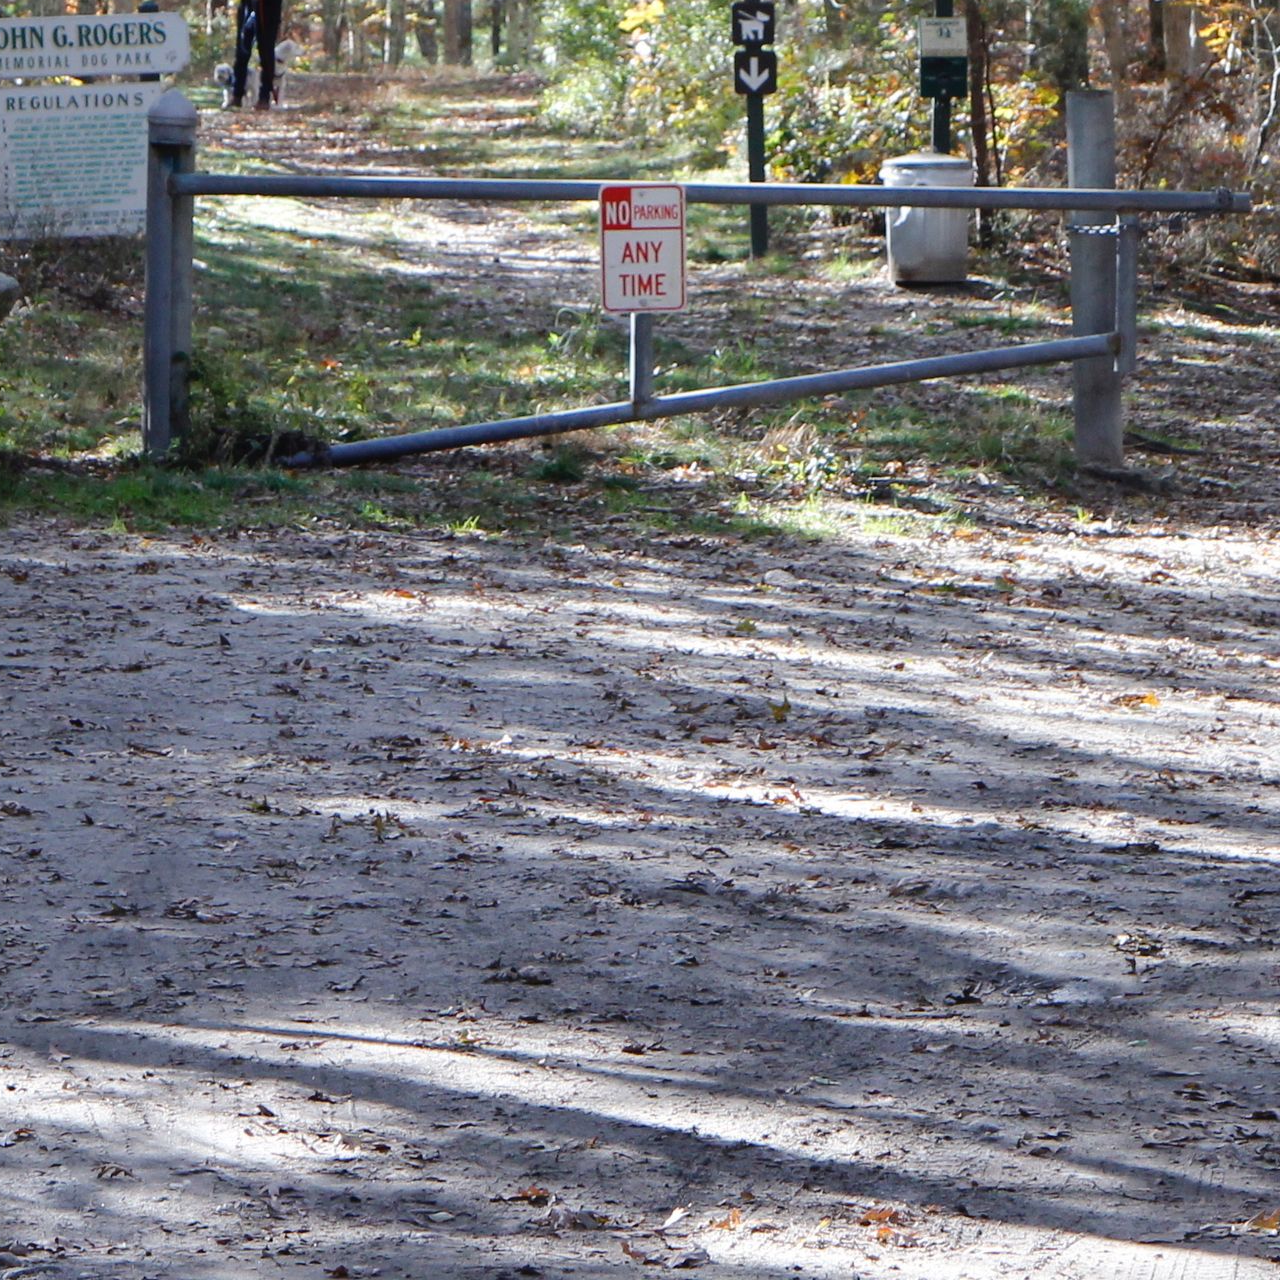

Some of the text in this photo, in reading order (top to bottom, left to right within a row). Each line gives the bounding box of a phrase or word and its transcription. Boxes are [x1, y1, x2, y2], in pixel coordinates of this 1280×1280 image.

[78, 21, 167, 47] ROGERS
[82, 52, 108, 67] DOG
[116, 51, 153, 66] PARK
[5, 92, 145, 112] REGULATIONS
[605, 200, 679, 225] NO PARKING
[621, 241, 663, 264] ANY
[618, 273, 667, 297] TIME
